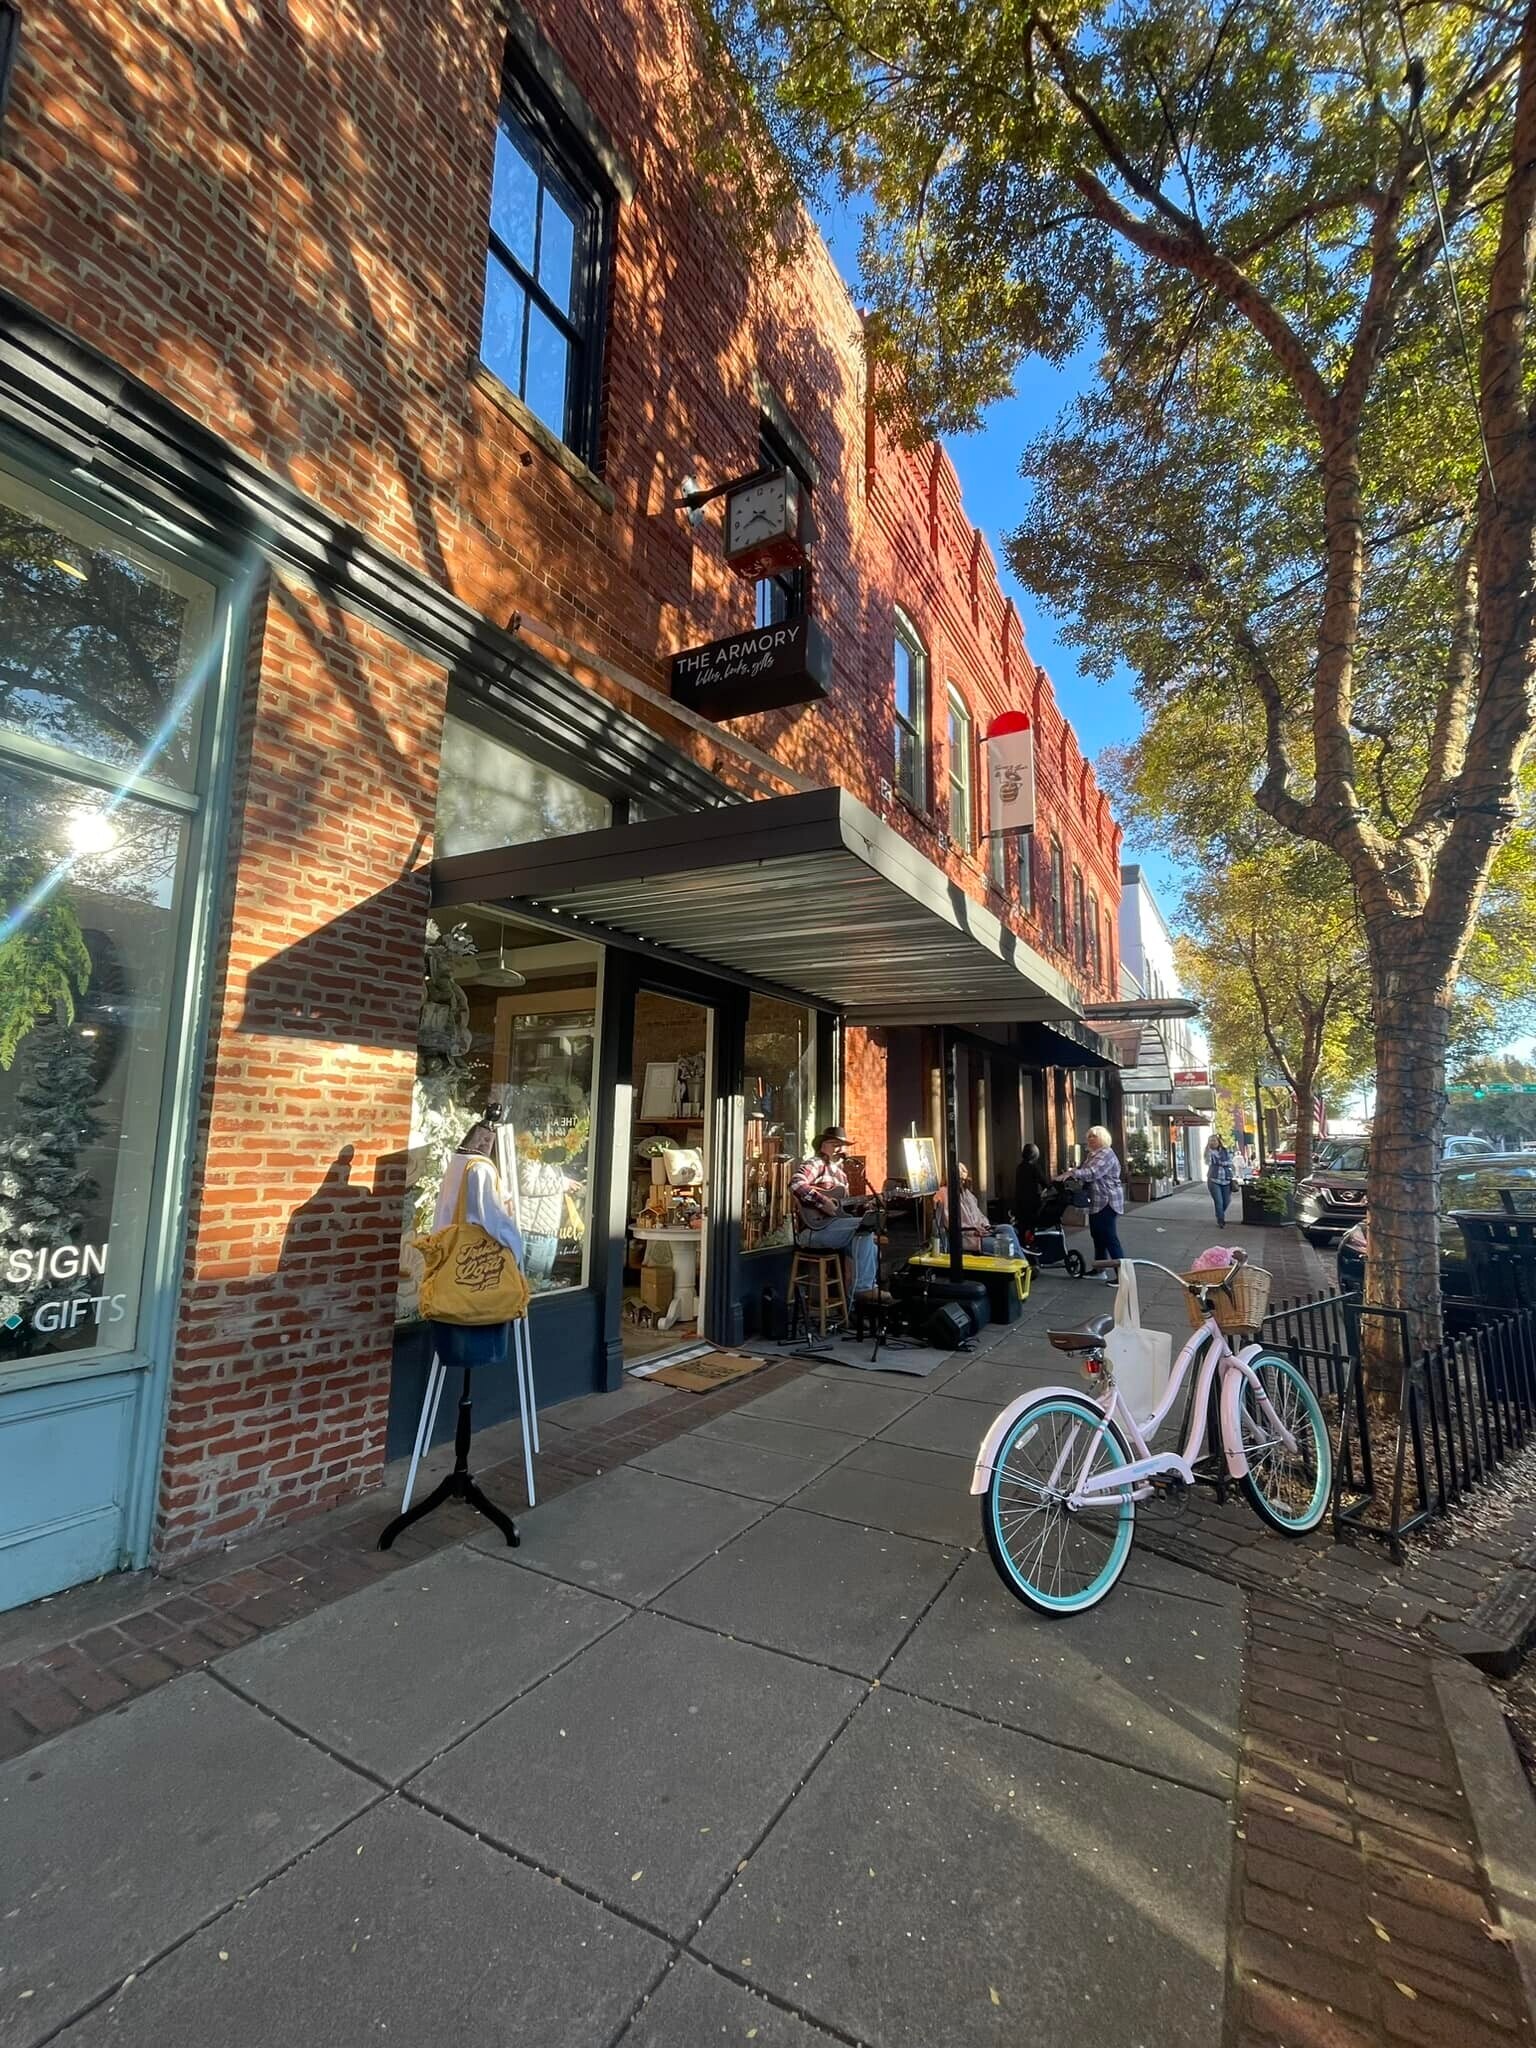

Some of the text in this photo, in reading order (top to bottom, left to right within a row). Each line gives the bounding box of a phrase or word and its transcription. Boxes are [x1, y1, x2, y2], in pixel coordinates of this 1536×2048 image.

[677, 626, 800, 674] THE ARMORY
[6, 1243, 109, 1283] SIGN
[34, 1294, 127, 1332] GIFTS
